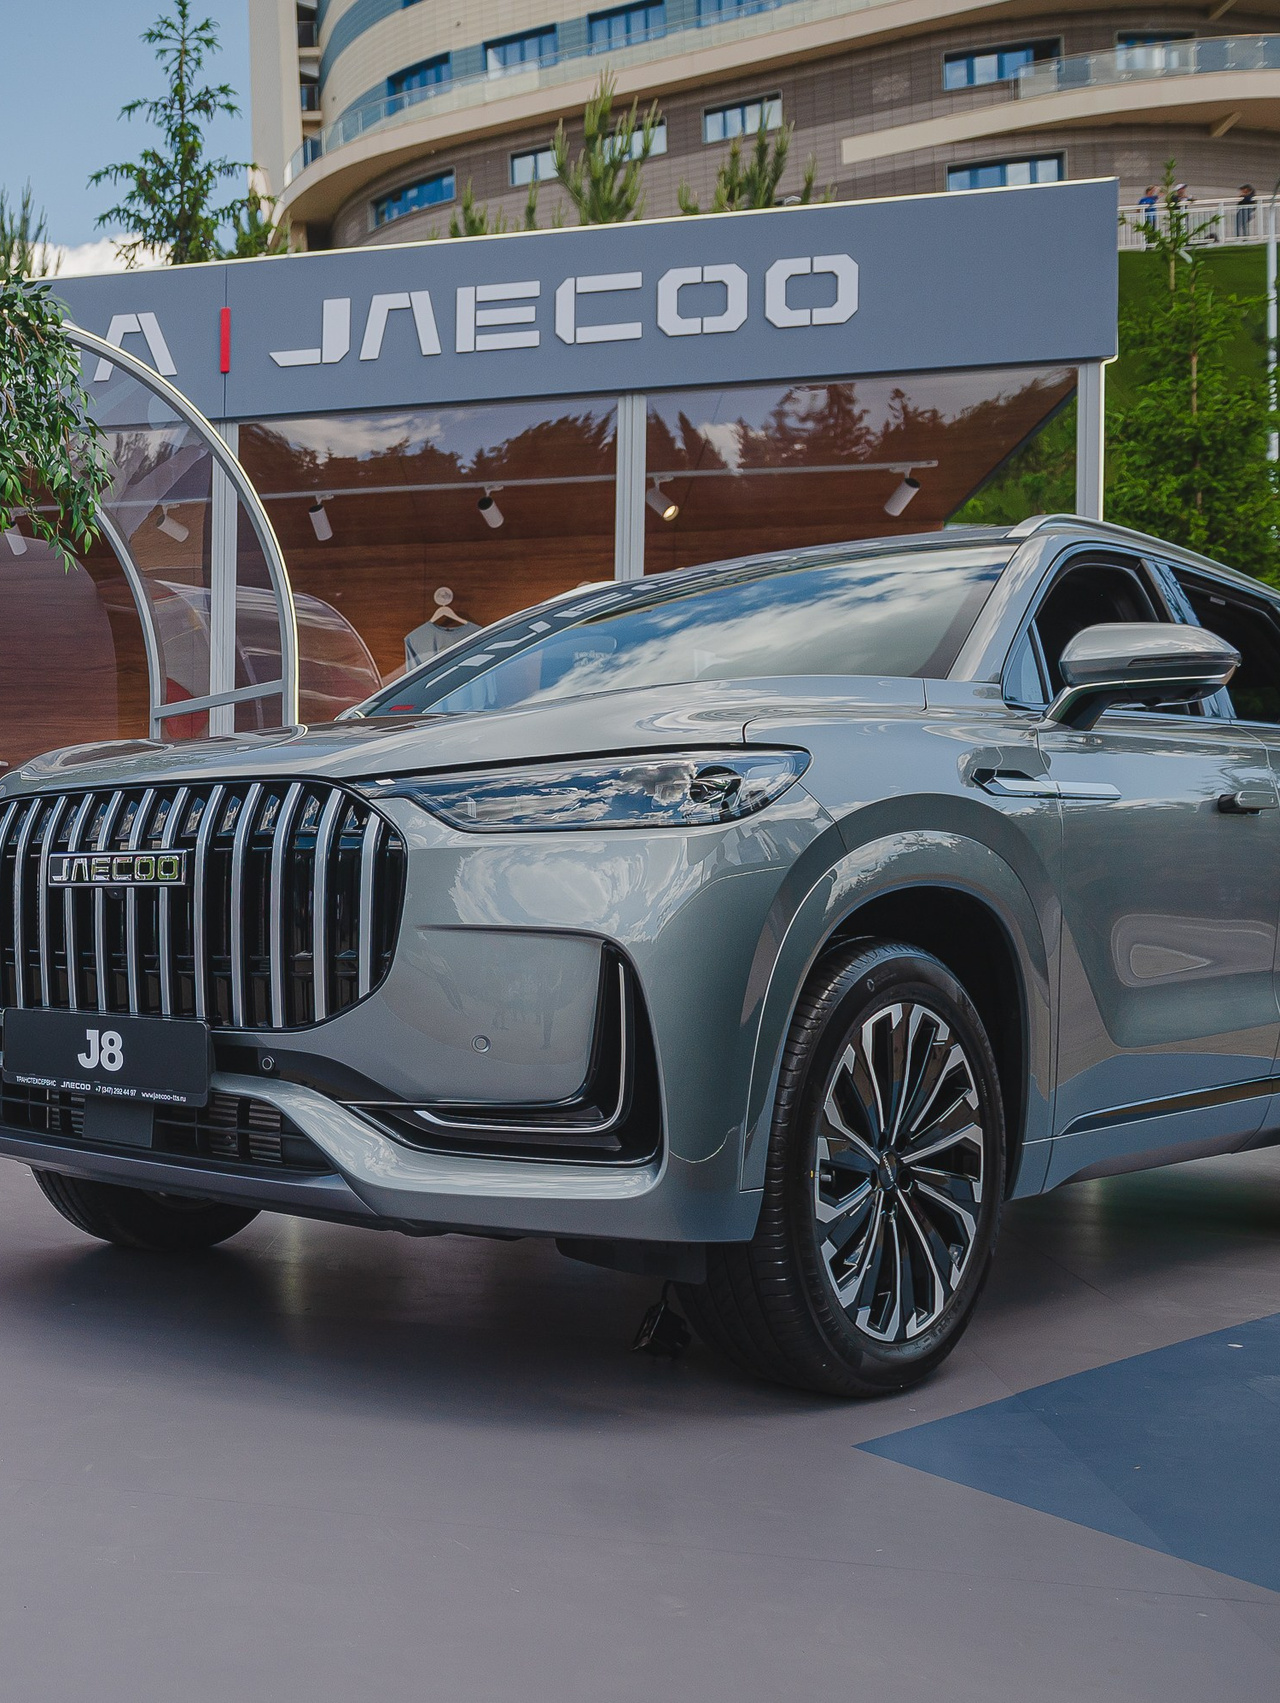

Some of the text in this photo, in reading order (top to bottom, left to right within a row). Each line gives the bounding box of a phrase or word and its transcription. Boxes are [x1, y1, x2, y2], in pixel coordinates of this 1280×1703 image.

[269, 253, 860, 367] JAECOO
[51, 855, 180, 882] JAECOO
[77, 1028, 124, 1072] J8
[60, 1081, 91, 1091] JAECOO
